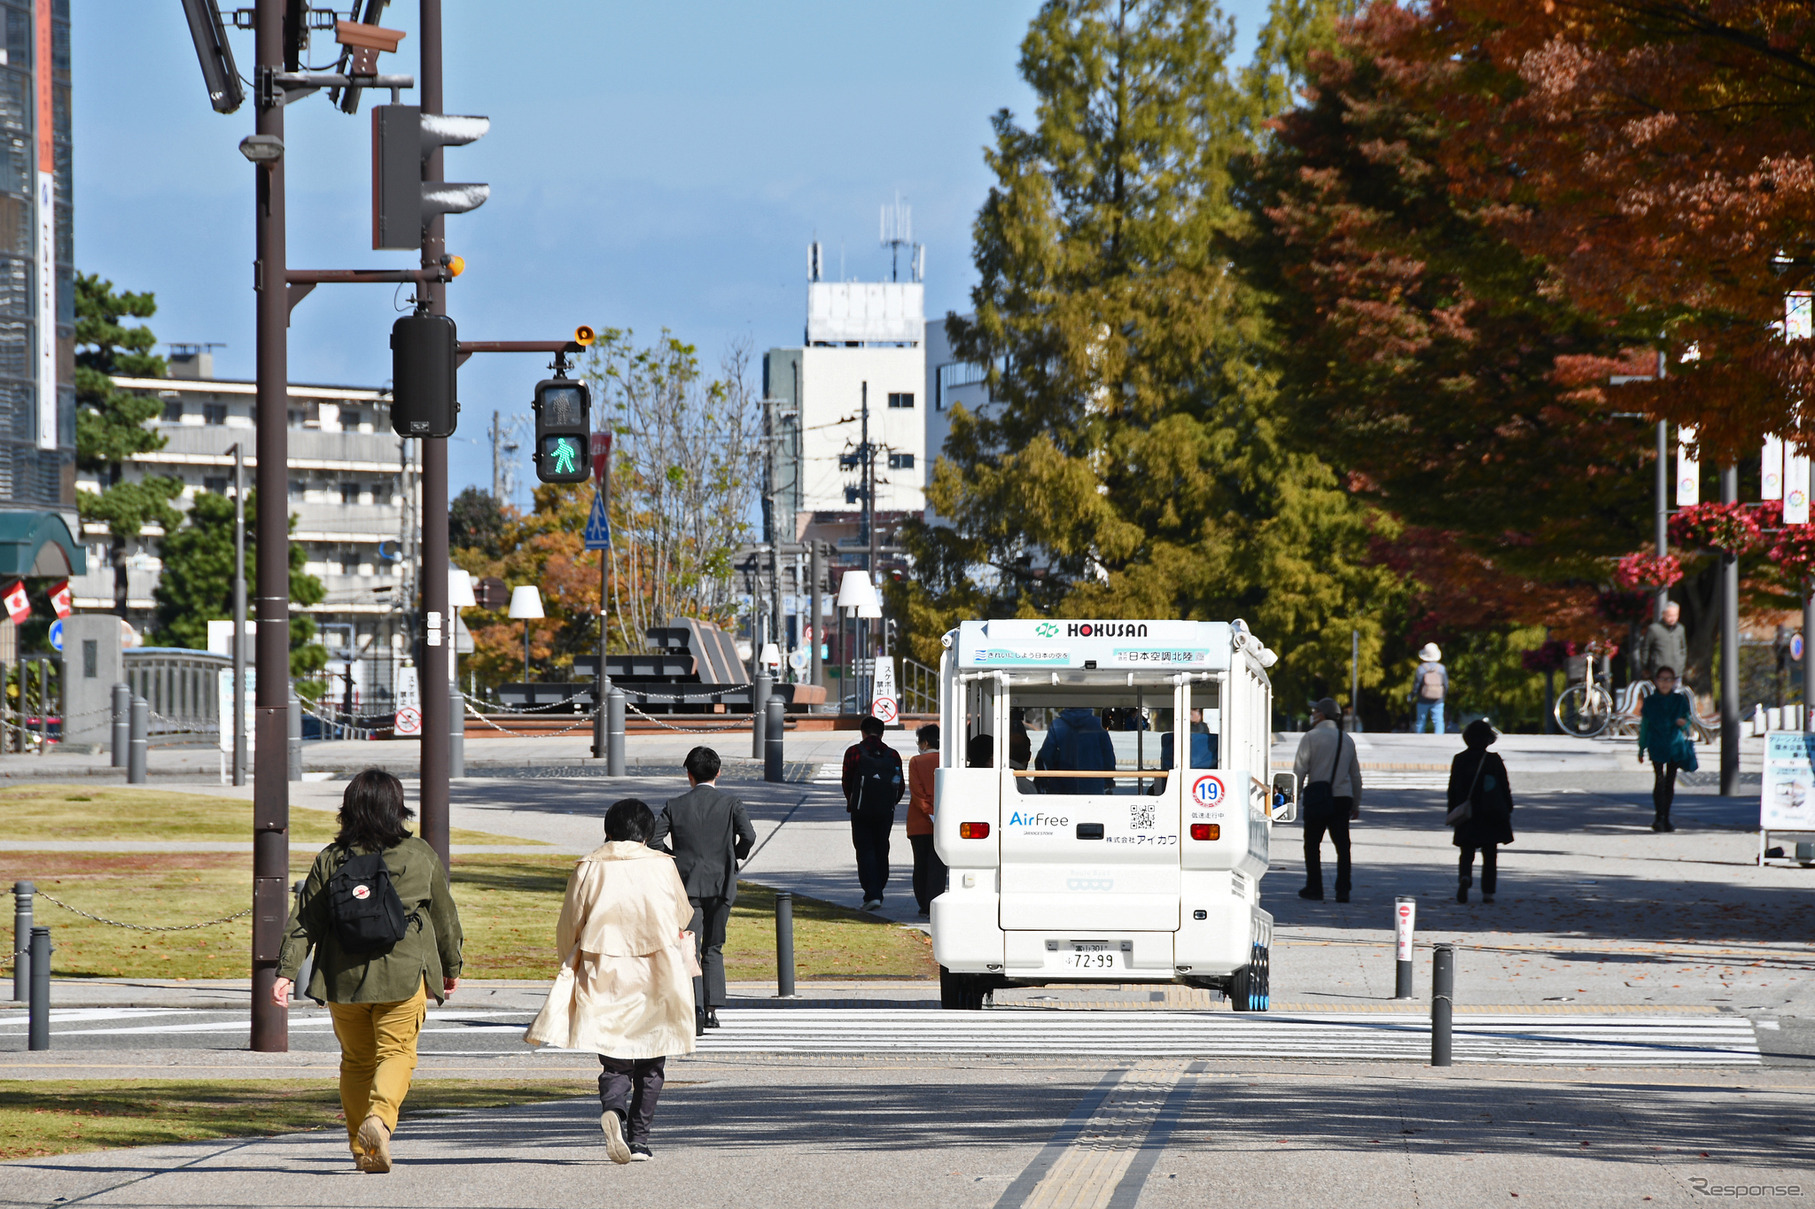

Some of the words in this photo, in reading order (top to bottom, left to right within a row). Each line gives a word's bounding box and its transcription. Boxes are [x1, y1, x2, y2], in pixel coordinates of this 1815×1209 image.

[1068, 623, 1147, 637] HOKUSAN
[987, 652, 1068, 660] きれいにしよう日本の空を
[1129, 651, 1193, 661] 日本空調北陸
[876, 681, 883, 695] 禁止
[1199, 782, 1217, 800] 19
[1009, 811, 1069, 827] AirFree
[1075, 954, 1113, 968] 72-99
